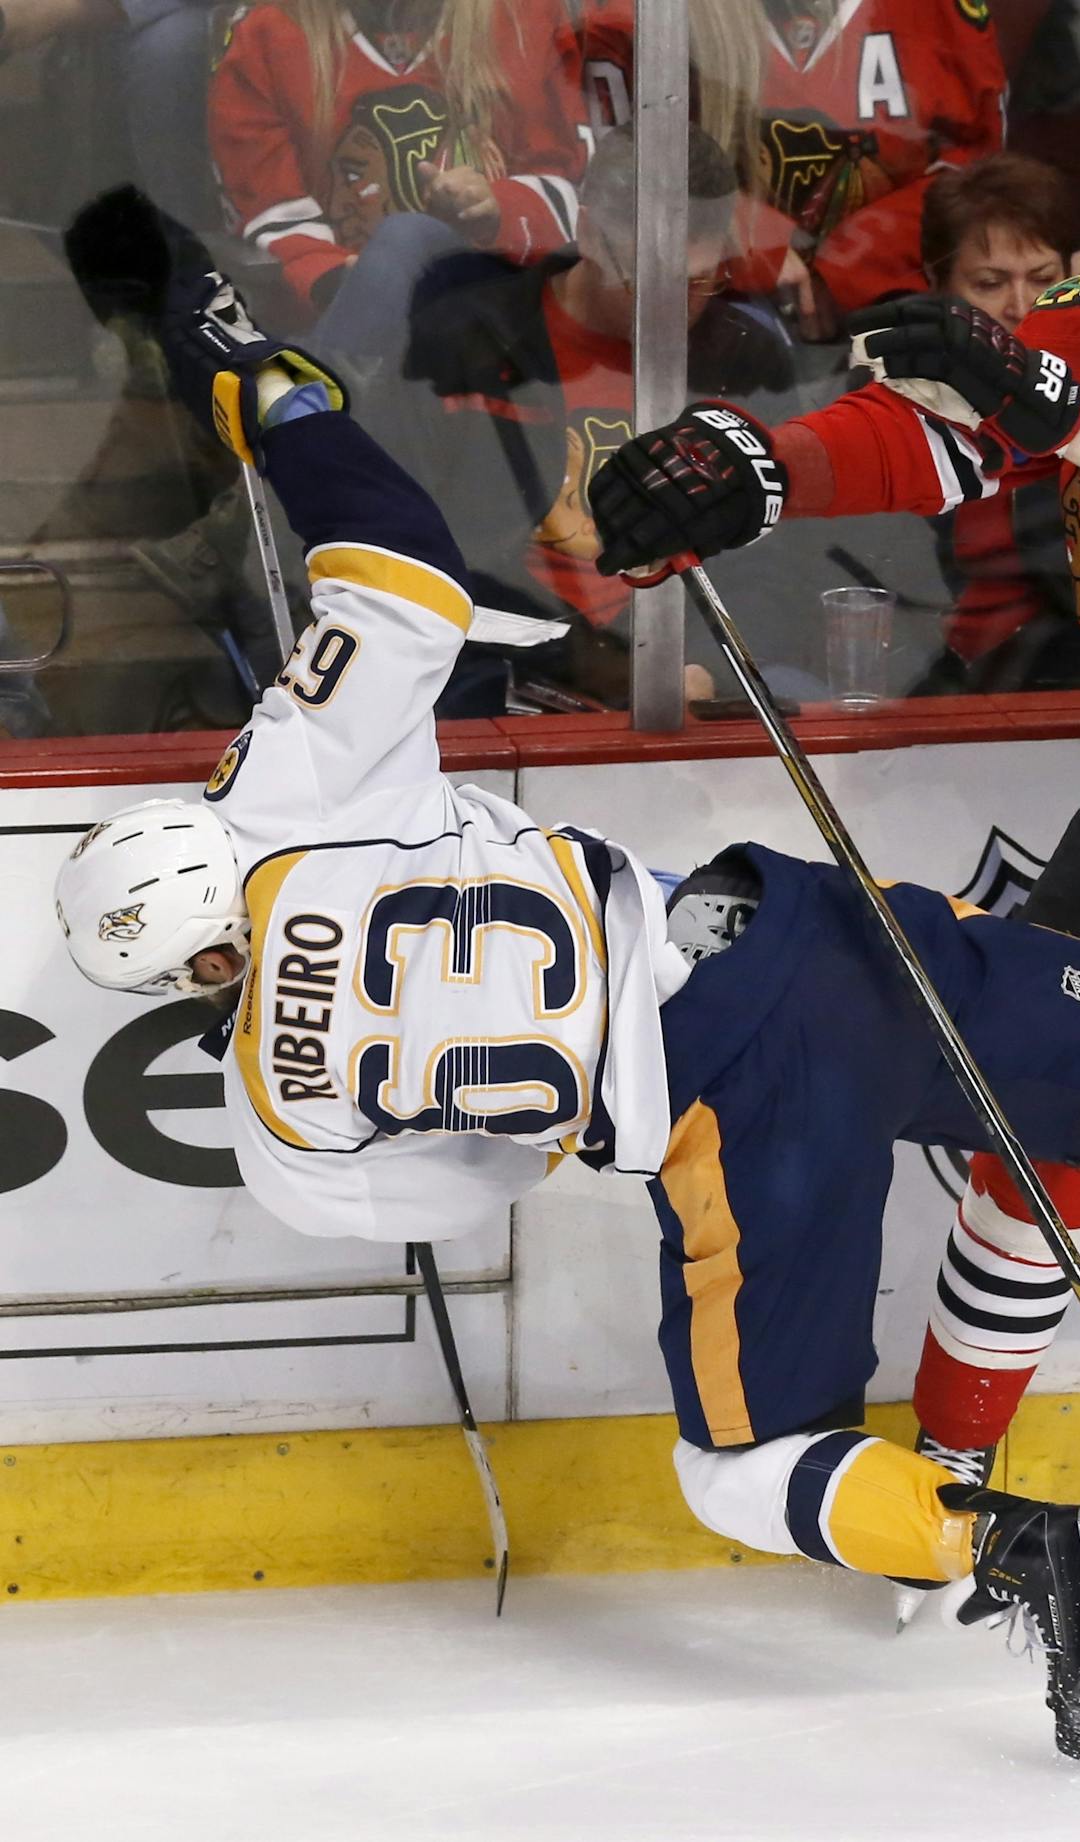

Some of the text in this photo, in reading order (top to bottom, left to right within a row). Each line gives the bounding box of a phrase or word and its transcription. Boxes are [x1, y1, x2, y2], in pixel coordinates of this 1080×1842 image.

[858, 32, 909, 119] A
[273, 912, 344, 1102] RIBEIRO
[348, 873, 590, 1138] 63
